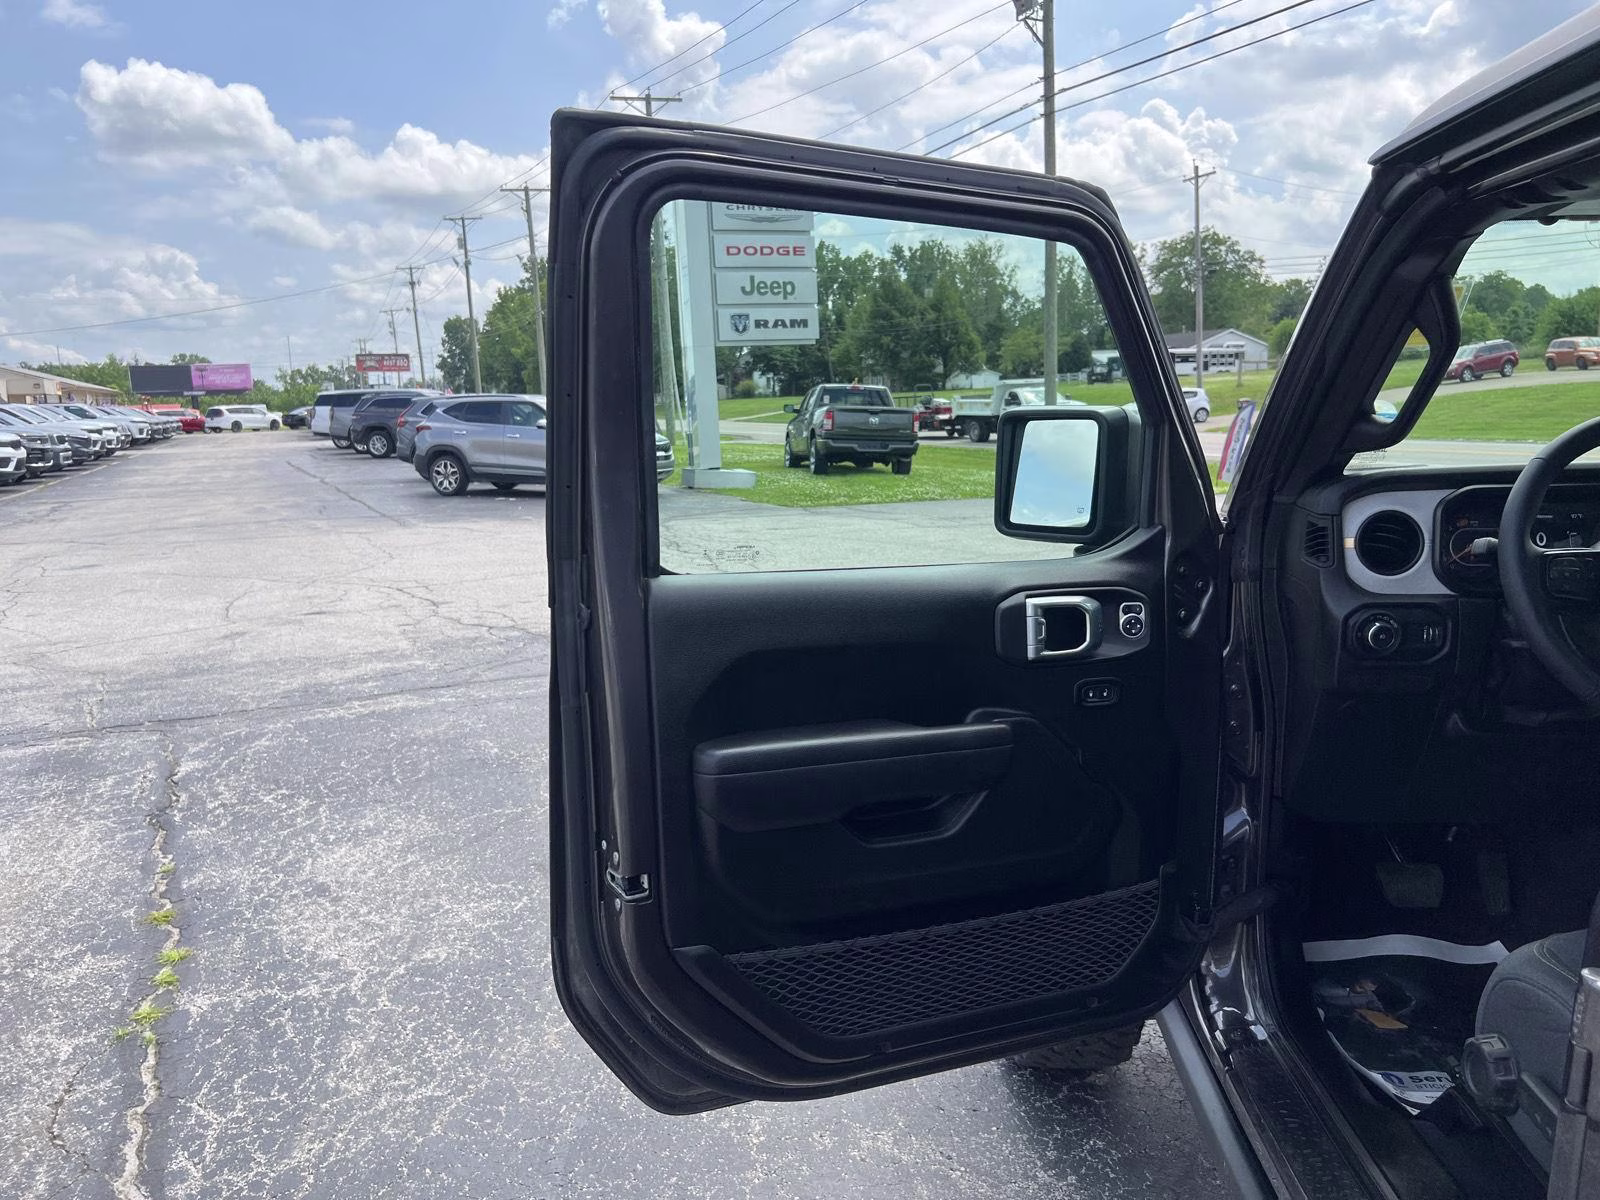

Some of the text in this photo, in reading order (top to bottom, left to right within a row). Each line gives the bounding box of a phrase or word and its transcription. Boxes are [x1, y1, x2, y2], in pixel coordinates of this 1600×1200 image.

[726, 204, 801, 212] CHRYSL
[726, 245, 806, 256] DODGE
[741, 275, 796, 300] Jeep
[754, 319, 809, 329] RAM
